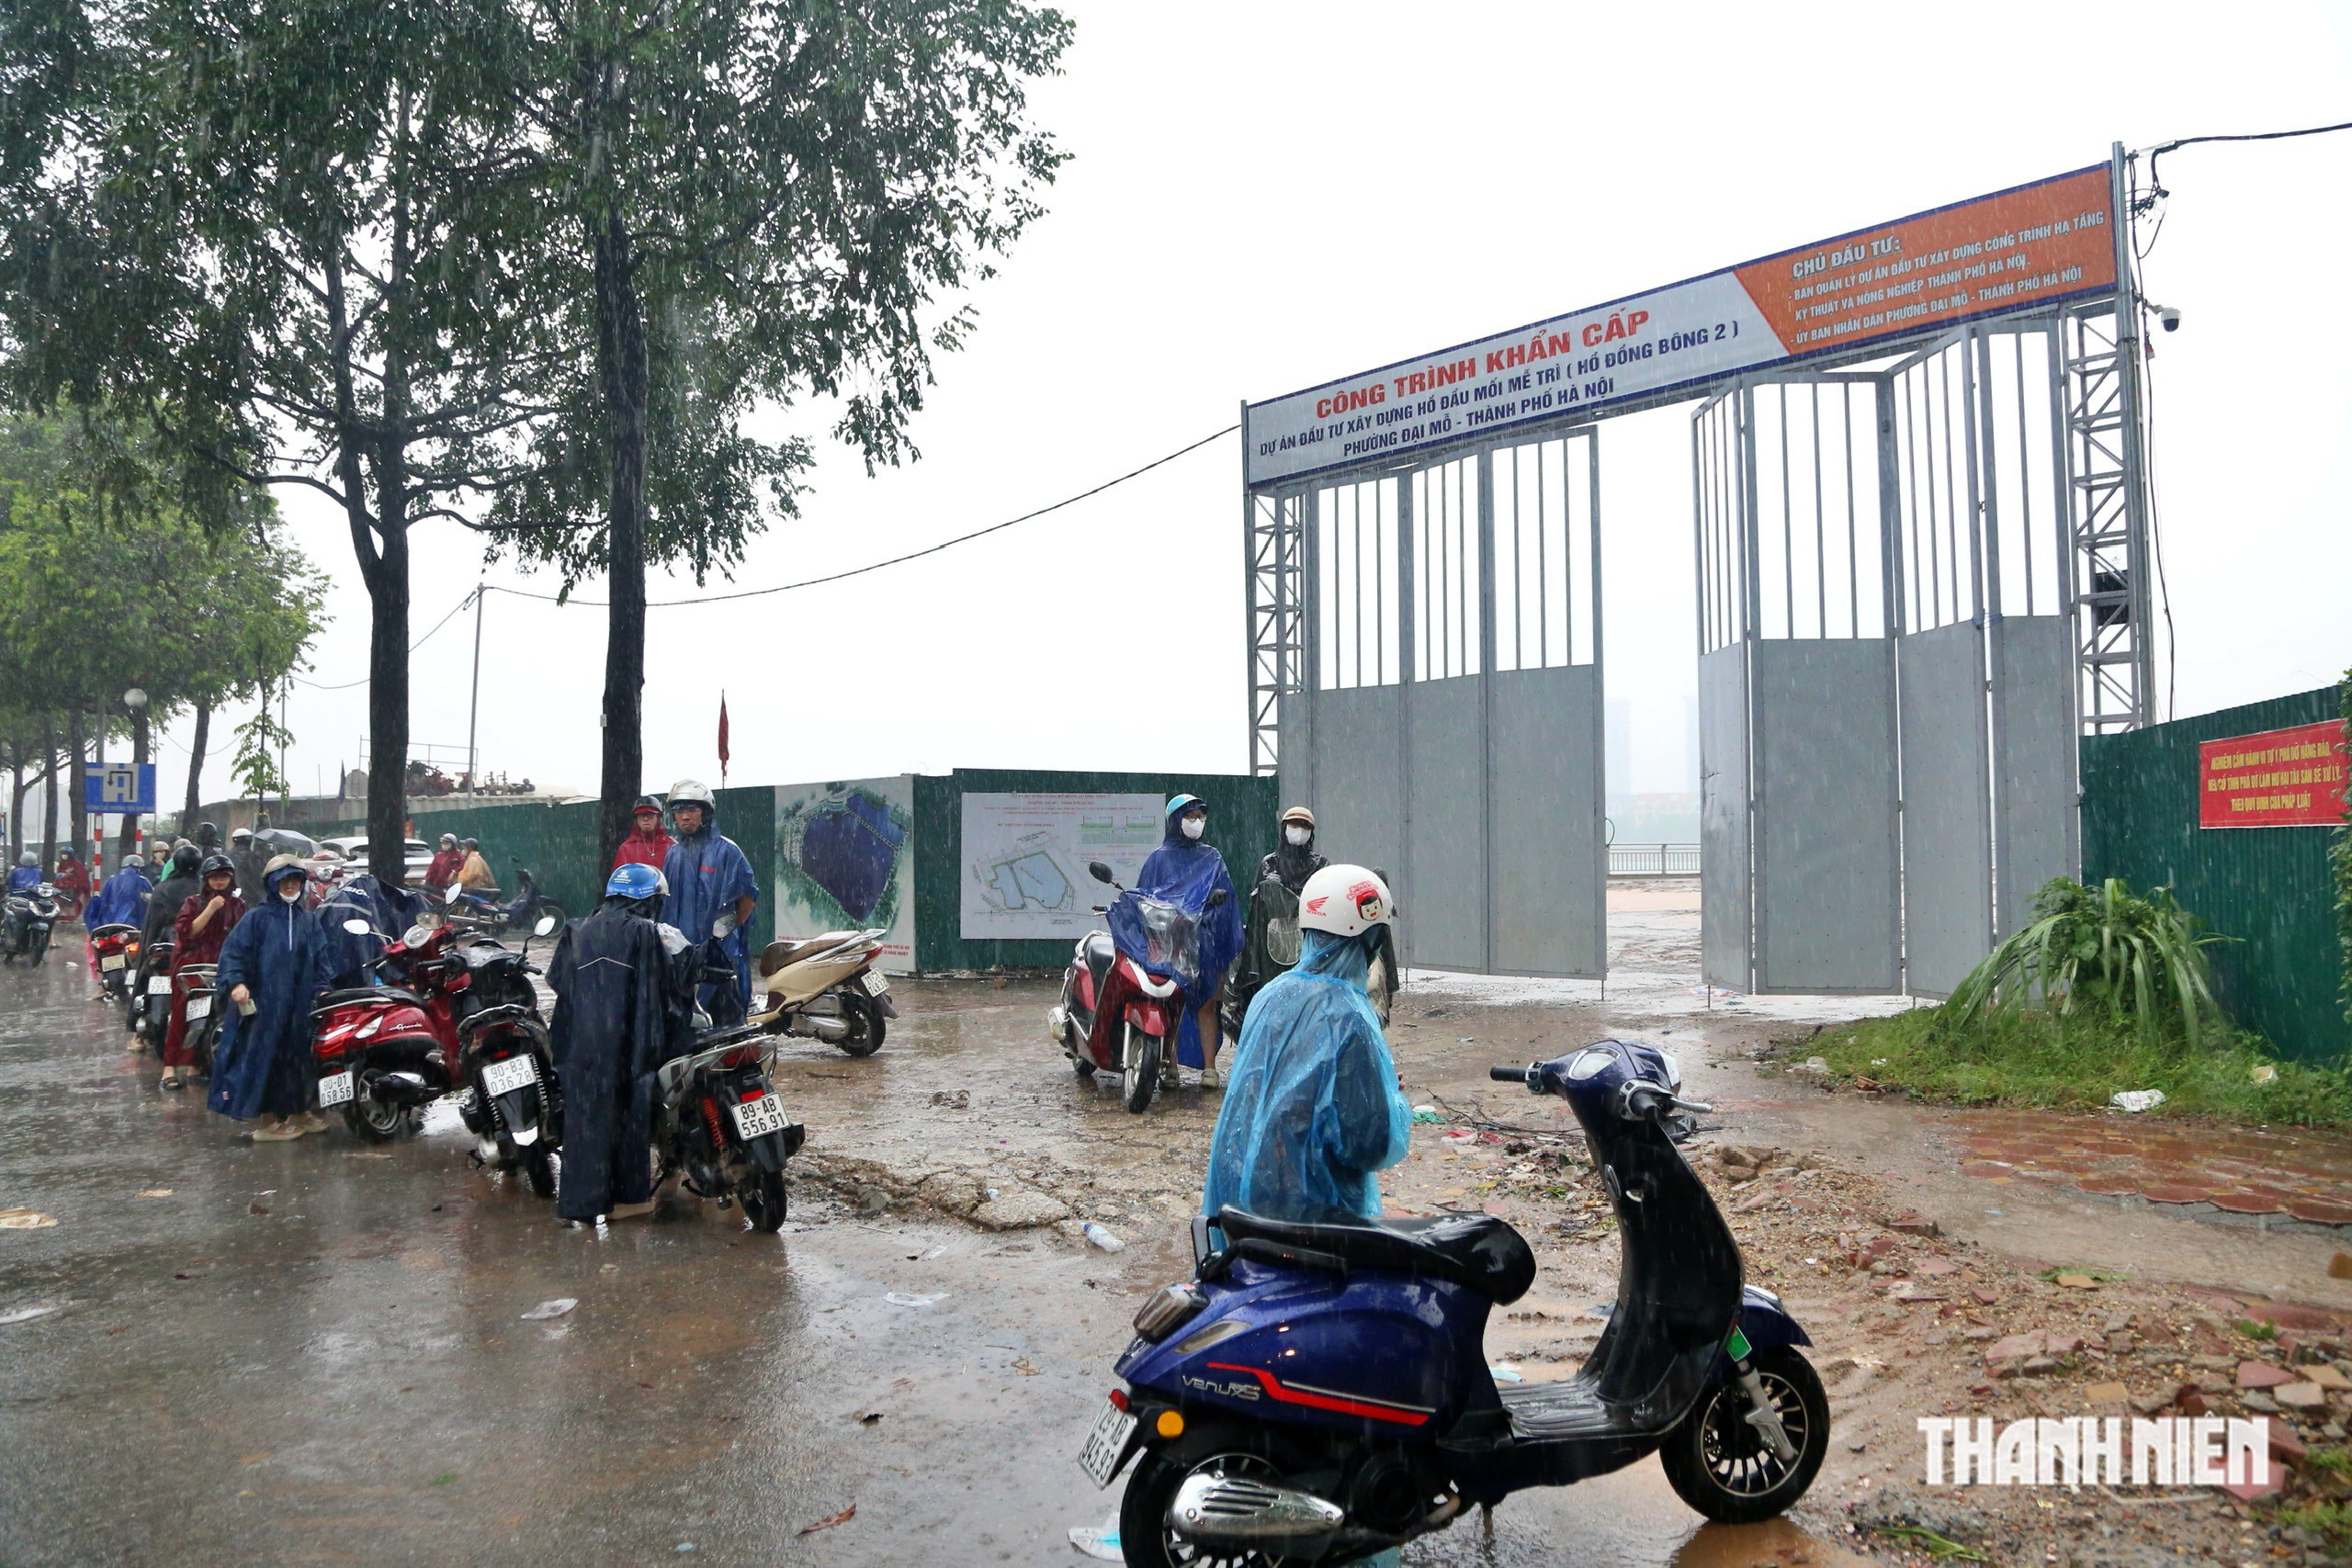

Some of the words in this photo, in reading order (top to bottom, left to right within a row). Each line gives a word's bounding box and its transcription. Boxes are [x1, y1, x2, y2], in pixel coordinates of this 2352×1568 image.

[1792, 251, 1826, 277] CHỦ
[1831, 243, 1865, 267] ĐẦU
[1870, 235, 1901, 256] TƯ:
[1794, 286, 1814, 300] BAN
[1845, 272, 1856, 288] LÝ
[1859, 269, 1872, 285] DỰ
[1874, 265, 1888, 279] ÁN
[1891, 257, 1911, 276] ĐẦU
[1914, 254, 1927, 269] TƯ
[1930, 250, 1950, 265] XÂY
[1952, 242, 1982, 260] DỰNG
[1985, 233, 2015, 252] CÔNG
[2018, 224, 2052, 243] TRÌNH
[2054, 220, 2070, 235] HẠ
[2073, 210, 2105, 230] TẦNG
[1810, 299, 1838, 317] THUẬT
[1841, 295, 1854, 310] VÀ
[1857, 288, 1883, 306] NÔNG
[1886, 279, 1924, 299] NGHIỆP
[1927, 269, 1962, 288] THÀNH
[1964, 258, 1986, 279] PHỐ
[1989, 257, 2004, 275] HÀ
[1811, 326, 1830, 341] BAN
[1834, 318, 1860, 335] NHÂN
[1863, 312, 1883, 329] DÂN
[1886, 301, 1928, 322] PHƯỜNG
[1930, 298, 1948, 313] ĐẠI
[1978, 283, 2014, 301] THÀNH
[2018, 272, 2040, 293] PHỐ
[2042, 269, 2058, 288] HÀ
[2062, 265, 2082, 284] NỘI
[1316, 383, 1385, 419] CÔNG
[1394, 357, 1476, 398] TRÌNH
[1487, 329, 1571, 373] KHẨN
[1582, 307, 1649, 347] CẤP
[1260, 439, 1276, 457] DỰ
[1280, 434, 1296, 451] ÁN
[1299, 425, 1324, 447] ĐẦU
[1329, 421, 1344, 439] TƯ
[1347, 415, 1372, 435] XÂY
[1376, 405, 1413, 429] DỰNG
[1418, 394, 1436, 416] HỒ
[1440, 388, 1469, 411] ĐẦU
[1474, 377, 1503, 401] MỐI
[1508, 367, 1531, 392] MỄ
[1536, 363, 1561, 386] TRÌ
[1577, 351, 1600, 375] HỒ
[1605, 344, 1653, 368] ĐỒNG
[1658, 328, 1709, 355] BÔNG
[1714, 323, 1726, 341] 2
[1343, 431, 1397, 457] PHƯỜNG
[1401, 424, 1425, 444] ĐẠI
[1429, 414, 1452, 436] MỖ
[1466, 400, 1516, 427] THÀNH
[1521, 387, 1553, 414] PHỐ
[1557, 383, 1579, 405] HÀ
[1585, 377, 1614, 400] NỘI
[490, 1058, 524, 1079] 90-B3
[490, 1070, 533, 1093] 036.28
[741, 1098, 777, 1120] 89-AB
[741, 1111, 786, 1136] 556.91
[1099, 1404, 1129, 1446] 29-AB
